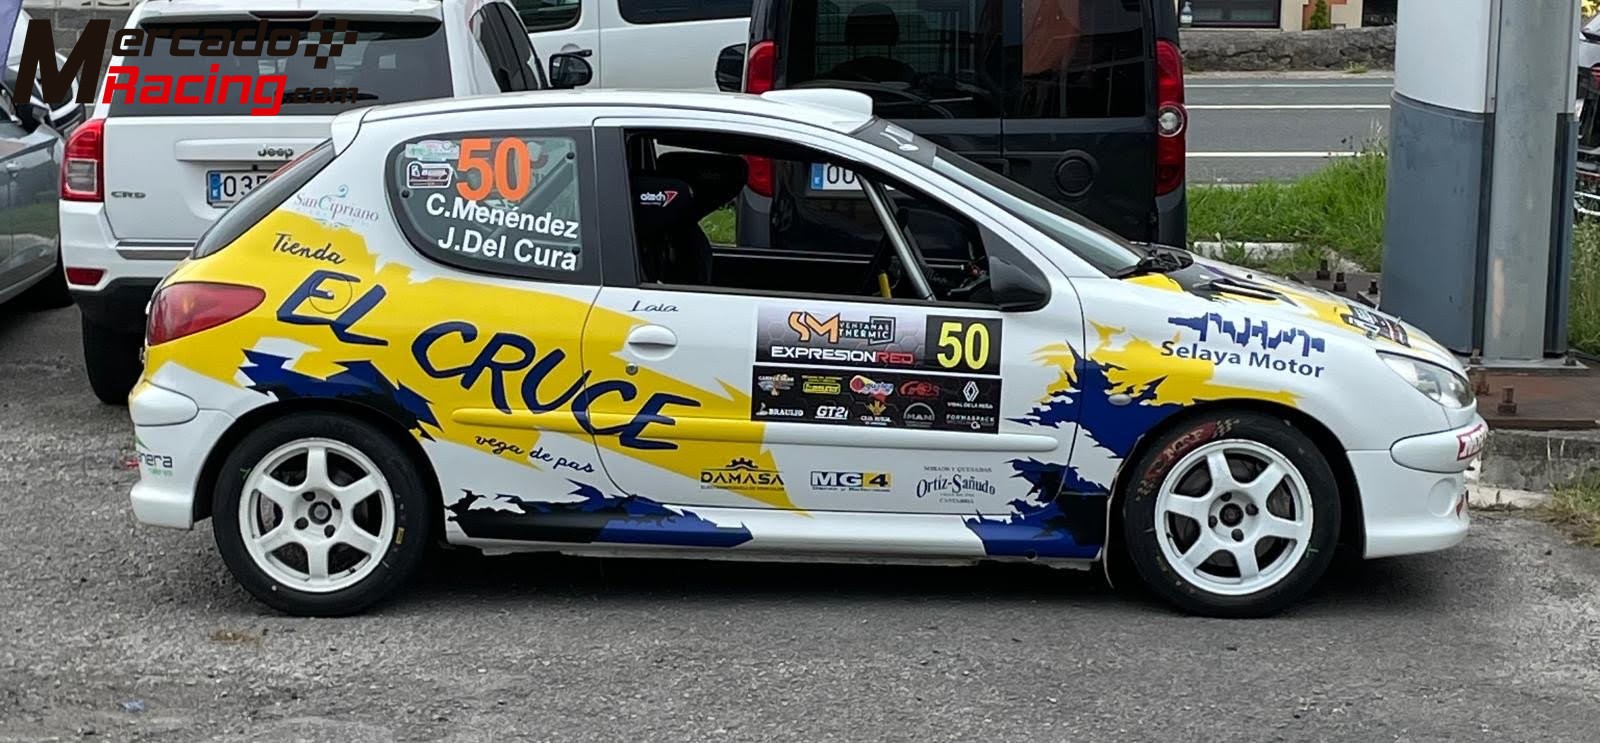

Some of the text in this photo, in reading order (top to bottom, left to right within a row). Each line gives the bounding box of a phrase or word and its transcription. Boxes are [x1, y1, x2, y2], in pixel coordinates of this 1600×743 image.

[257, 146, 294, 158] Jeep
[456, 137, 531, 202] 50
[111, 191, 146, 199] CRD
[426, 193, 579, 240] C.Menéndez
[274, 233, 346, 265] Tienda
[438, 226, 578, 271] J.Del Cura
[788, 311, 840, 344] SM
[839, 329, 890, 339] THERMIC
[276, 269, 701, 450] EL CRUCE
[936, 321, 990, 370] 50
[1161, 340, 1325, 378] Selaya Motor
[768, 408, 804, 416] BRAULIO
[475, 435, 595, 474] vega de pas
[701, 471, 785, 486] DAMASA
